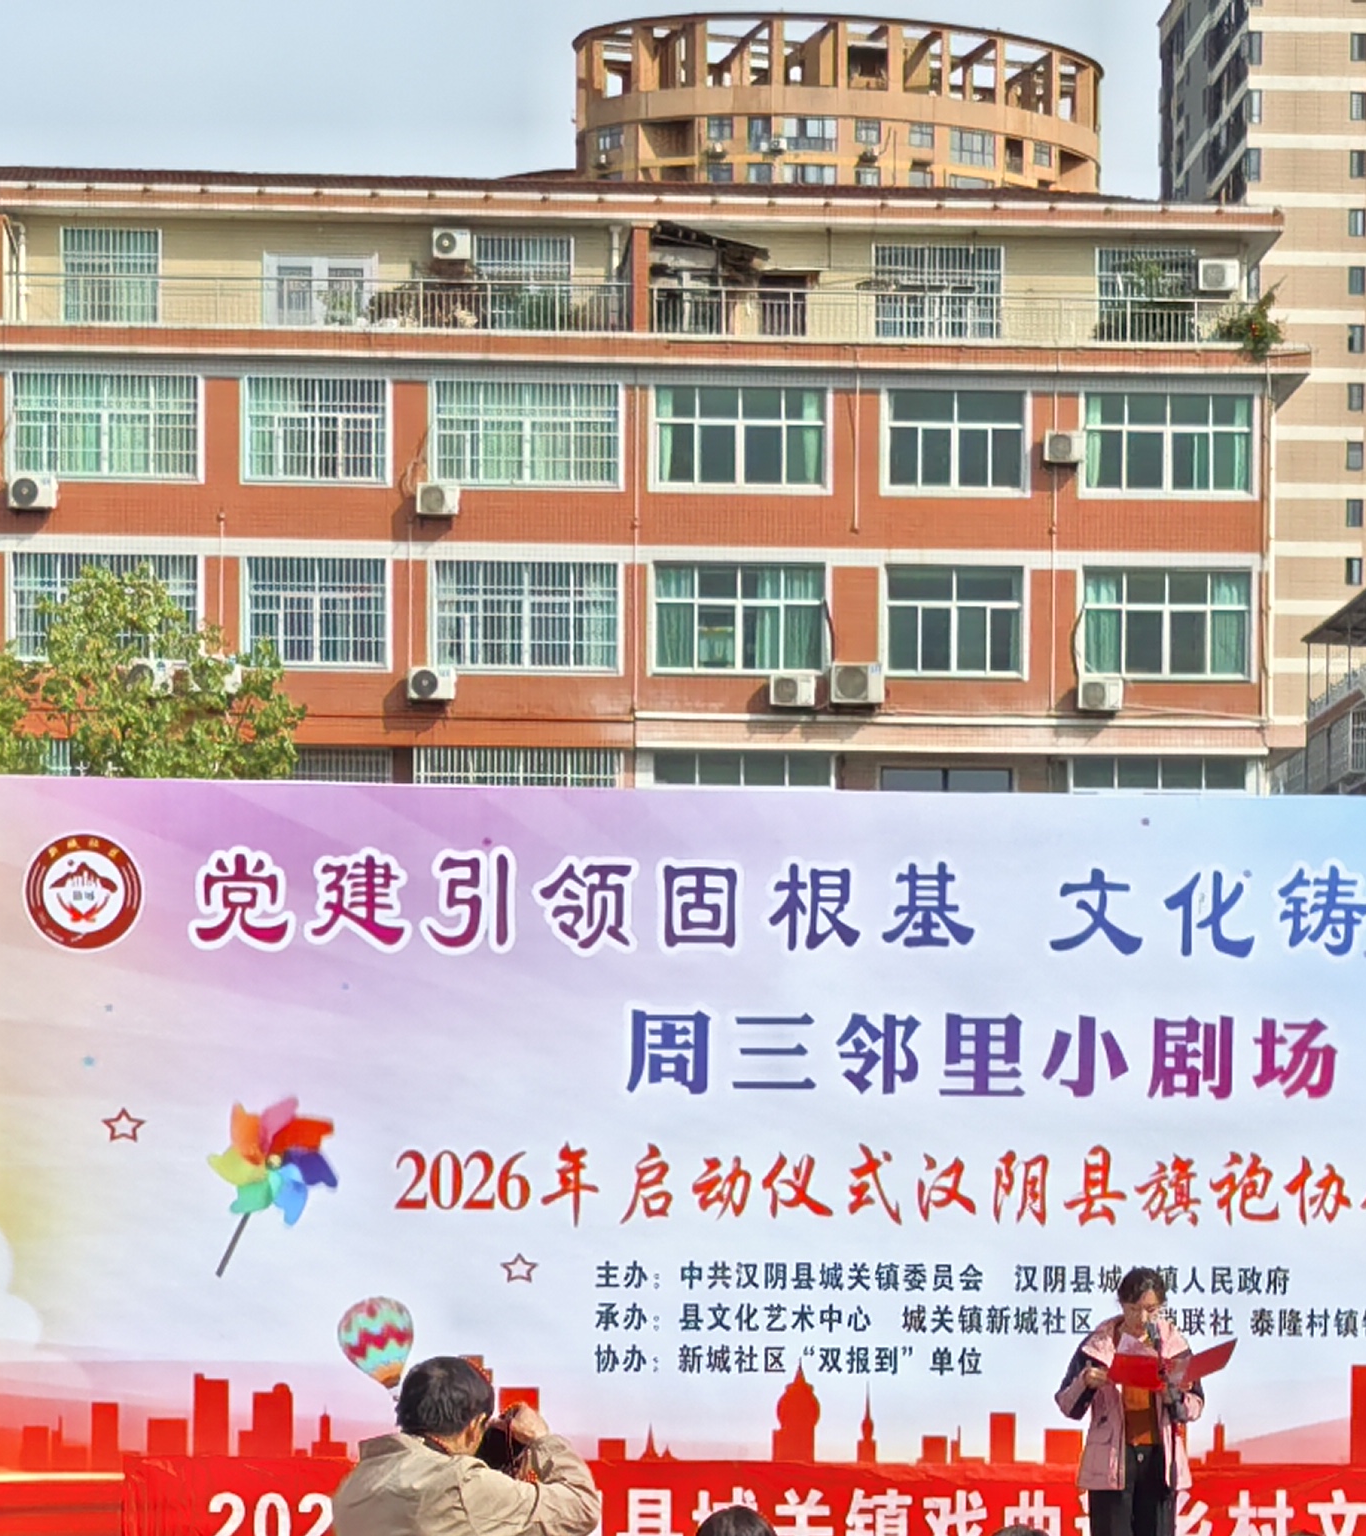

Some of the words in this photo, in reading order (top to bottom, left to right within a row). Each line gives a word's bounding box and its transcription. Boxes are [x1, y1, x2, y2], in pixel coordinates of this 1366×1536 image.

[192, 853, 974, 949] 党建引领固根基
[626, 1008, 1338, 1101] 周三邻里小剧场
[1014, 1263, 1291, 1296] 汉阴县城镇人民政府
[902, 1304, 1095, 1336] 城关镇新城社区
